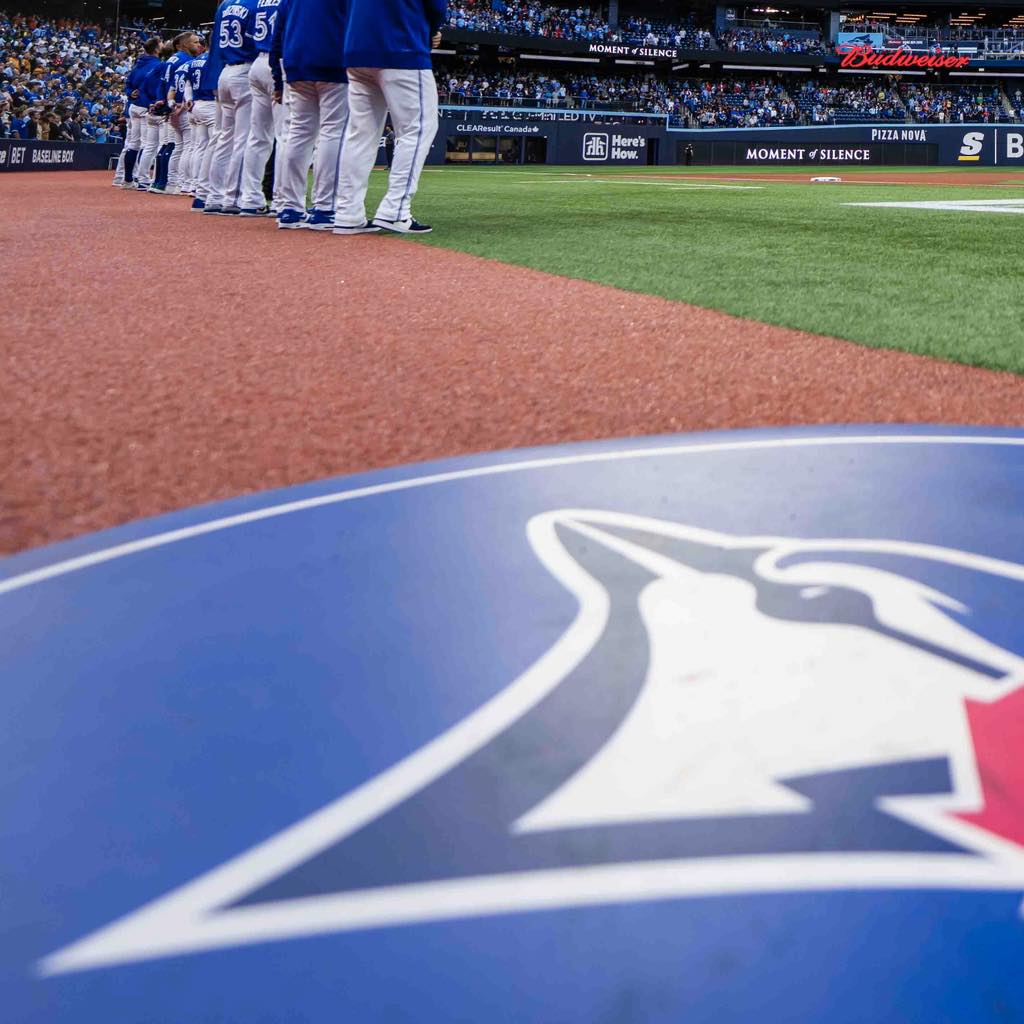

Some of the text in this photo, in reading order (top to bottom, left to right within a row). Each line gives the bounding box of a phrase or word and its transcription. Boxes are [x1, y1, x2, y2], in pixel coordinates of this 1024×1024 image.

[219, 19, 243, 48] 53
[589, 44, 678, 57] MOMENT of SILENCE
[836, 45, 969, 68] Budweiser
[456, 124, 533, 133] CLEAResult Canada
[871, 128, 926, 142] PIZZA NOVA
[611, 134, 646, 148] Here's
[959, 131, 984, 156] S
[11, 147, 26, 164] BET
[32, 149, 61, 163] BASELINE
[62, 150, 75, 163] BOX
[611, 148, 639, 160] How.
[746, 148, 870, 160] MOMENT of SILENCE
